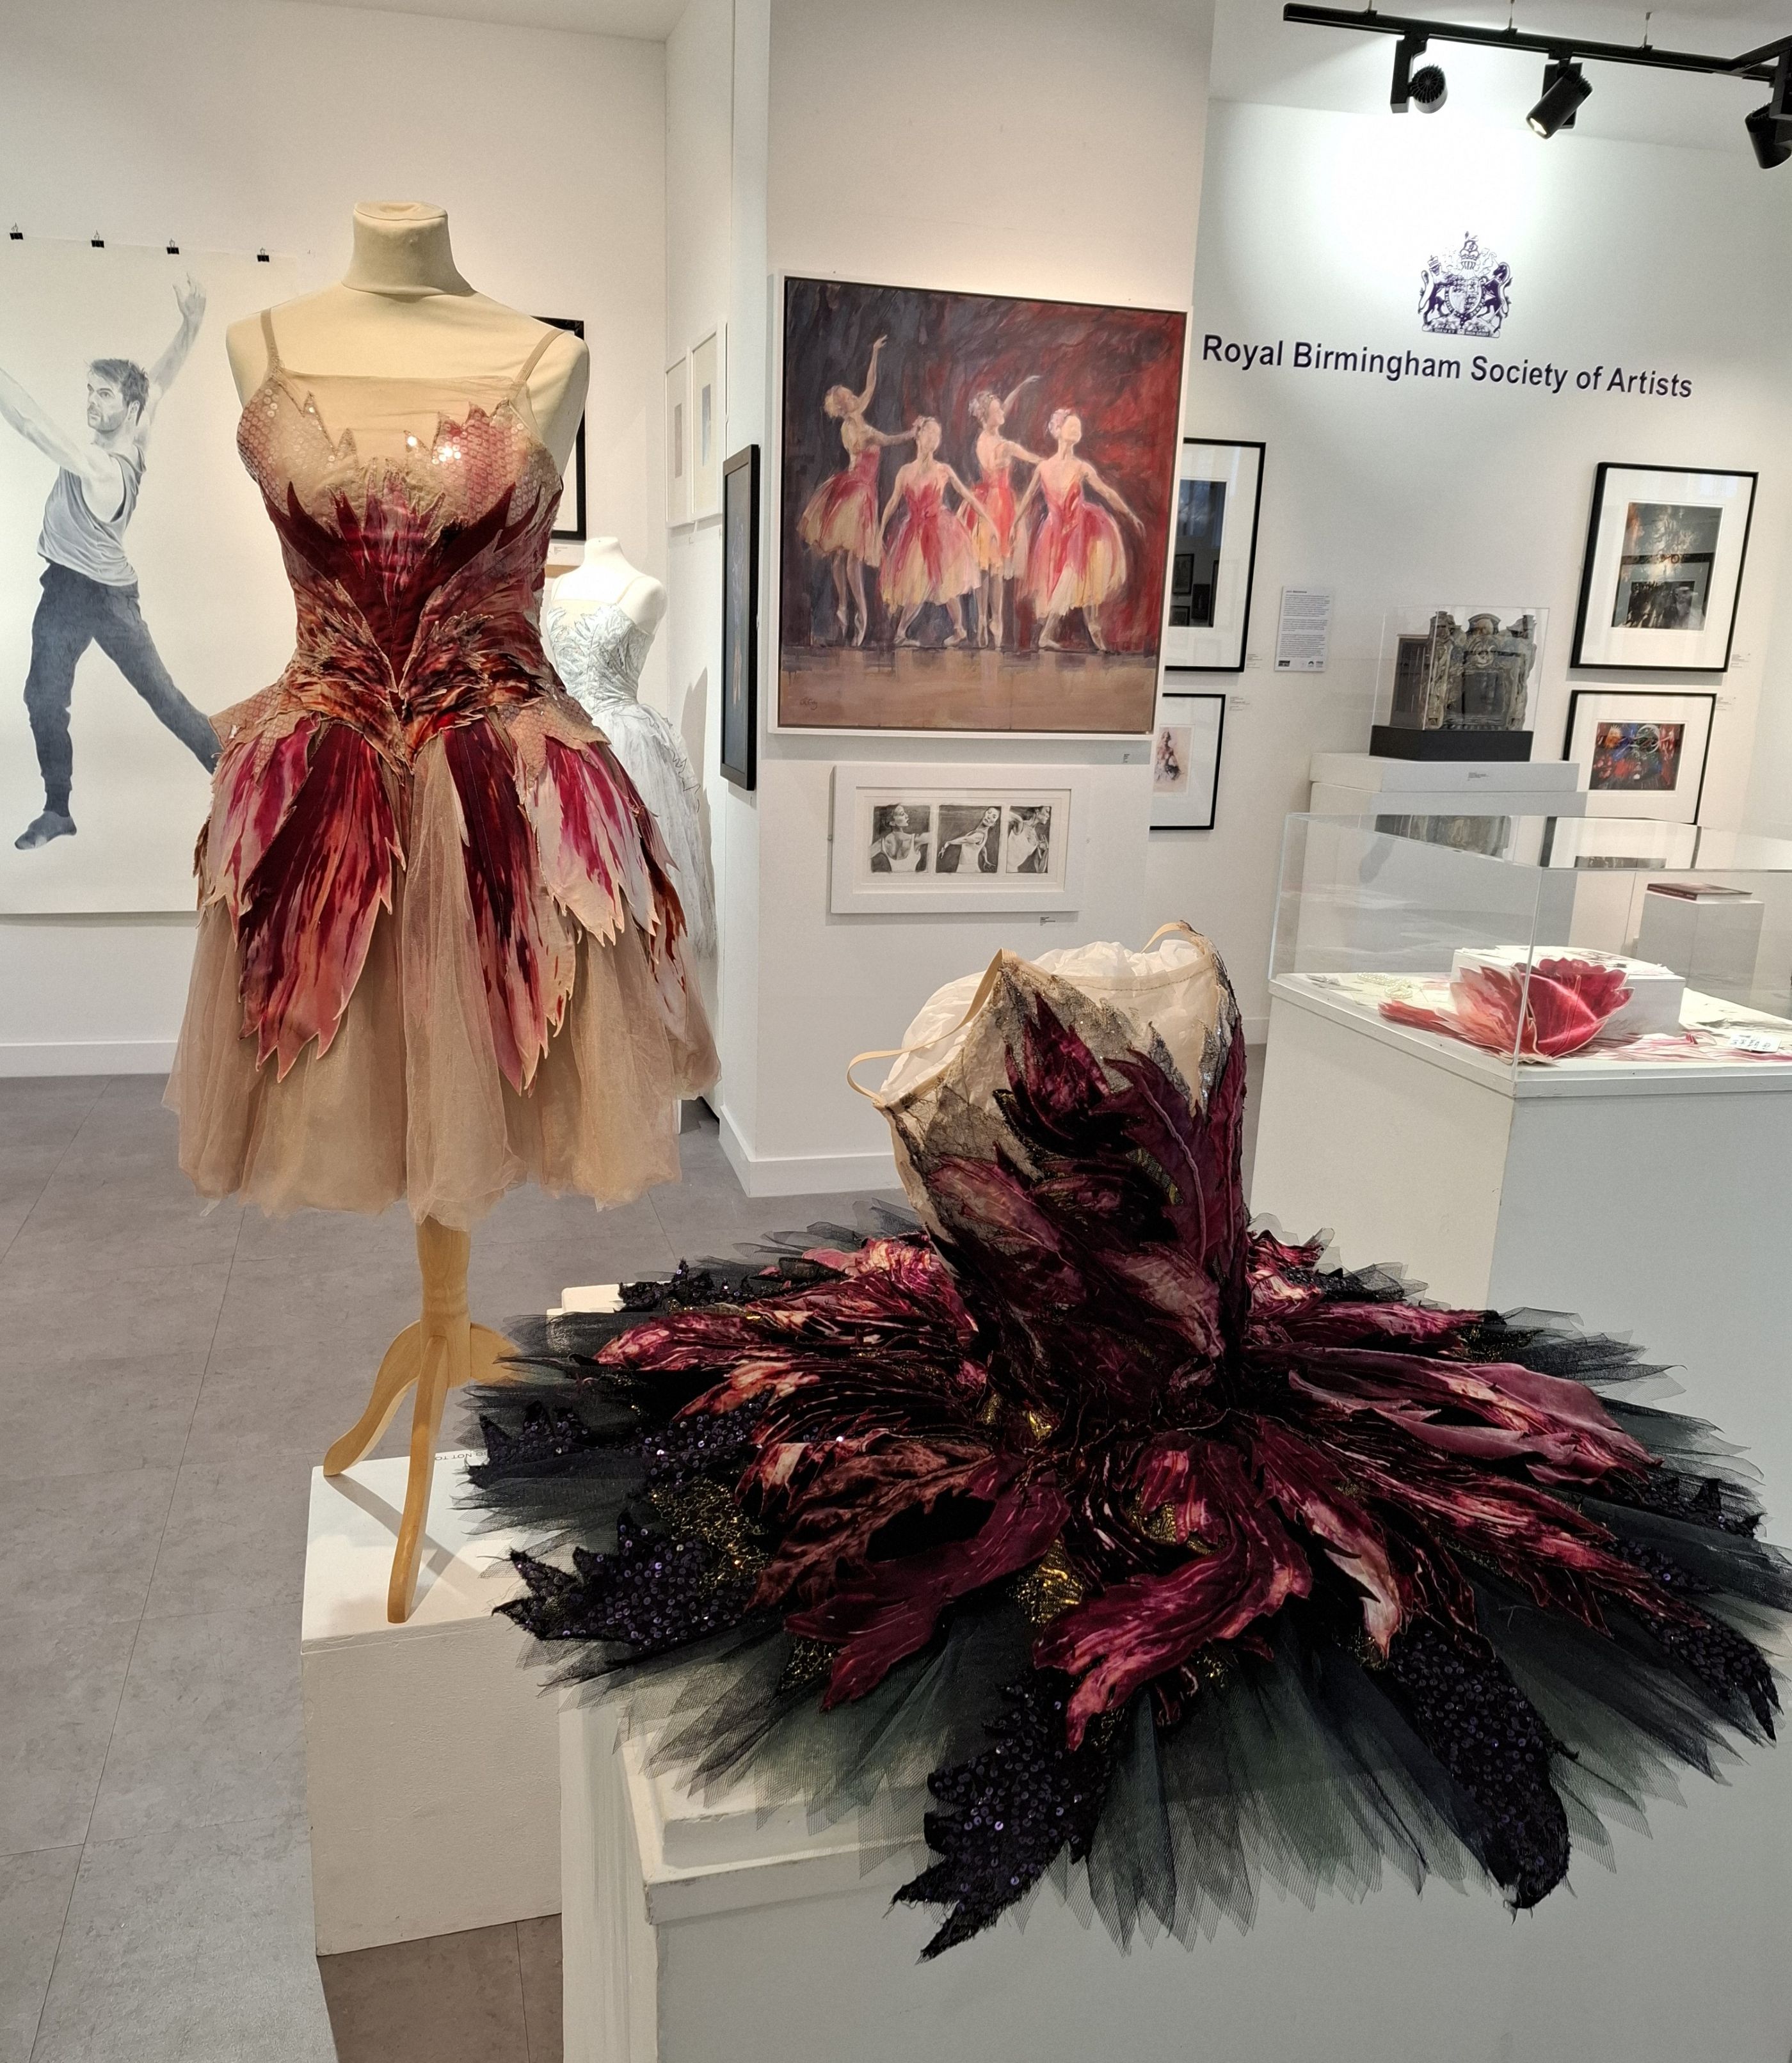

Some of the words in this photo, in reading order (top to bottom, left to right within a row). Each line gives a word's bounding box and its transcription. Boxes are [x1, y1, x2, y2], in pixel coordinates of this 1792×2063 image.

[1203, 334, 1283, 371] Royal
[1293, 341, 1460, 381] Birmingham
[1471, 355, 1569, 394] Society
[1576, 365, 1604, 390] of
[1606, 367, 1692, 398] Artists
